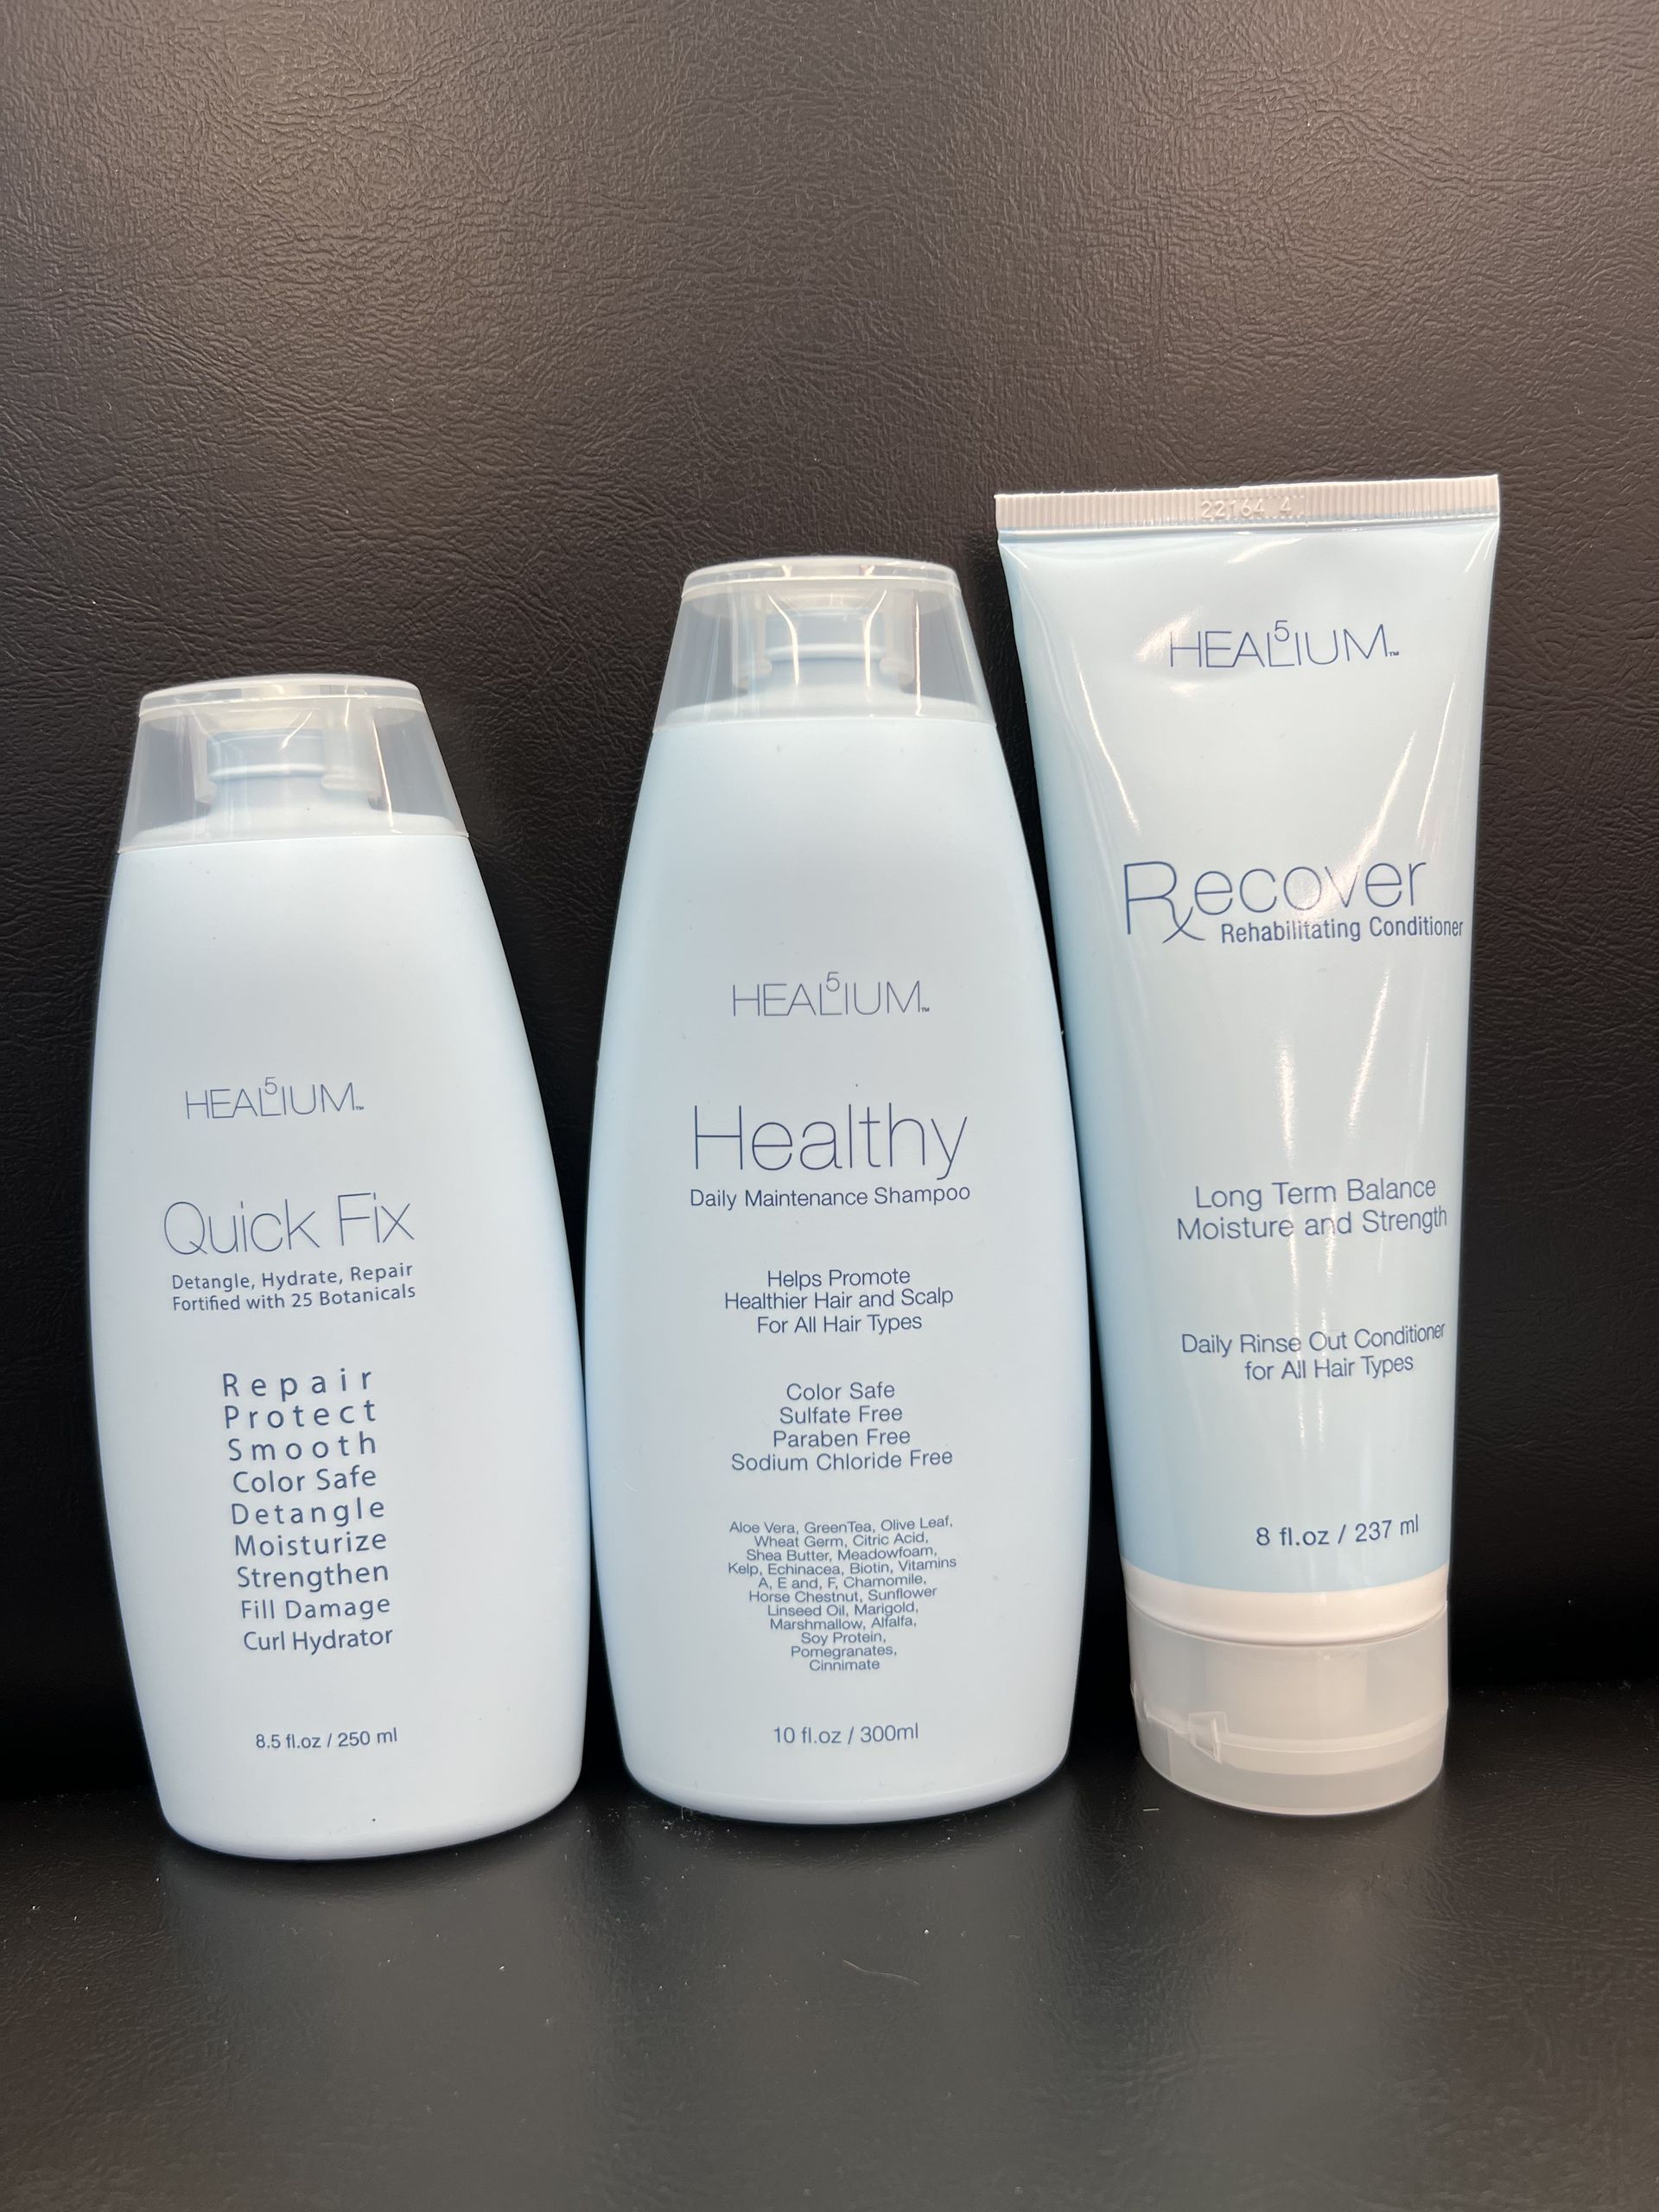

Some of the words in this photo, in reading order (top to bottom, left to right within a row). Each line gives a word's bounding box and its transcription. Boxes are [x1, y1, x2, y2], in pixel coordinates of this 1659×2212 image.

[1221, 918, 1361, 944] Rehabilitating
[1369, 914, 1464, 938] Conditioner
[694, 1102, 968, 1180] Healthy
[690, 1188, 737, 1211] Daily
[745, 1188, 868, 1208] Maintenance
[874, 1185, 970, 1205] Shampoo
[1195, 1185, 1262, 1212] Long
[1271, 1181, 1337, 1205] Term
[1347, 1177, 1436, 1202] Balance
[163, 1198, 321, 1255] Quick
[337, 1192, 415, 1247] Fix
[1176, 1216, 1294, 1241] Moisture
[1304, 1211, 1352, 1236] and
[1362, 1205, 1447, 1235] Strength
[172, 1272, 256, 1293] Detangle,
[261, 1268, 343, 1291] Hydrate,
[350, 1262, 413, 1283] Repair
[767, 1269, 823, 1291] Helps
[829, 1268, 911, 1287] Promote
[172, 1294, 241, 1312] Fortified
[246, 1292, 286, 1310] with
[291, 1292, 314, 1308] 25
[319, 1283, 416, 1306] Botanicals
[724, 1292, 808, 1310] Healthier
[814, 1291, 853, 1309] Hair
[858, 1289, 894, 1308] and
[900, 1287, 954, 1308] Scalp
[757, 1316, 789, 1334] For
[793, 1315, 817, 1334] All
[823, 1314, 862, 1333] Hair
[866, 1313, 923, 1335] Types
[1181, 1332, 1232, 1358] Daily
[1240, 1332, 1302, 1354] Rinse
[1308, 1330, 1348, 1352] Out
[1354, 1321, 1446, 1349] Conditioner
[1244, 1360, 1274, 1381] for
[1281, 1359, 1306, 1380] All
[1313, 1357, 1356, 1379] Hair
[1360, 1354, 1414, 1380] Types
[222, 1367, 372, 1402] Repair
[785, 1382, 842, 1401] Color
[849, 1381, 895, 1400] Safe
[224, 1399, 377, 1430] Protect
[779, 1406, 851, 1425] Sulfate
[858, 1404, 903, 1423] Free
[227, 1430, 377, 1462] Smooth
[772, 1429, 859, 1448] Paraben
[866, 1427, 911, 1446] Free
[731, 1452, 809, 1471] Sodium
[816, 1451, 902, 1471] Chloride
[909, 1448, 953, 1467] Free
[232, 1470, 306, 1494] Color
[315, 1464, 378, 1491] Safe
[231, 1497, 385, 1528] Detangle
[728, 1521, 760, 1534] Aloe
[763, 1522, 799, 1535] Vera,
[880, 1518, 916, 1532] Olive
[919, 1515, 953, 1529] Leaf,
[753, 1535, 799, 1548] Wheat
[804, 1535, 848, 1549] Germ,
[852, 1534, 889, 1547] Citric
[893, 1531, 929, 1545] Acid,
[1255, 1526, 1270, 1547] 8
[1279, 1526, 1330, 1547] fl.oz
[1355, 1518, 1393, 1542] 237
[1400, 1513, 1419, 1536] ml
[234, 1530, 388, 1557] Moisturize
[746, 1548, 782, 1561] Shea
[786, 1548, 833, 1563] Butter,
[837, 1546, 938, 1561] Meadowfoam,
[236, 1561, 389, 1592] Strengthen
[728, 1562, 763, 1577] Kelp,
[767, 1563, 844, 1577] Echinacea,
[849, 1561, 894, 1575] Biotin,
[897, 1556, 957, 1572] Vitamins
[758, 1577, 773, 1591] A,
[777, 1577, 787, 1589] E
[791, 1576, 823, 1591] and,
[827, 1577, 839, 1591] F,
[842, 1573, 927, 1589] Chamomile,
[241, 1599, 276, 1620] Fill
[284, 1594, 391, 1620] Damage
[749, 1590, 791, 1604] Horse
[794, 1589, 863, 1604] Chestnut,
[868, 1586, 938, 1601] Sunflower
[767, 1605, 822, 1617] Linseed
[826, 1604, 849, 1618] Oil,
[854, 1601, 919, 1617] Marigold,
[770, 1617, 866, 1631] Marshmallow,
[870, 1615, 917, 1629] Alfalfa,
[242, 1630, 285, 1652] Curl
[292, 1625, 394, 1656] Hydrator
[800, 1631, 829, 1646] Soy
[832, 1630, 887, 1643] Protein,
[791, 1644, 898, 1660] Pomegranates,
[809, 1658, 880, 1672] Cinnimate
[255, 1733, 282, 1750] 8.5
[284, 1732, 321, 1749] fl.oz
[337, 1730, 372, 1748] 250
[376, 1726, 398, 1745] ml
[773, 1726, 796, 1745] 10
[801, 1726, 842, 1745] fl.oz
[860, 1722, 919, 1743] 300ml
